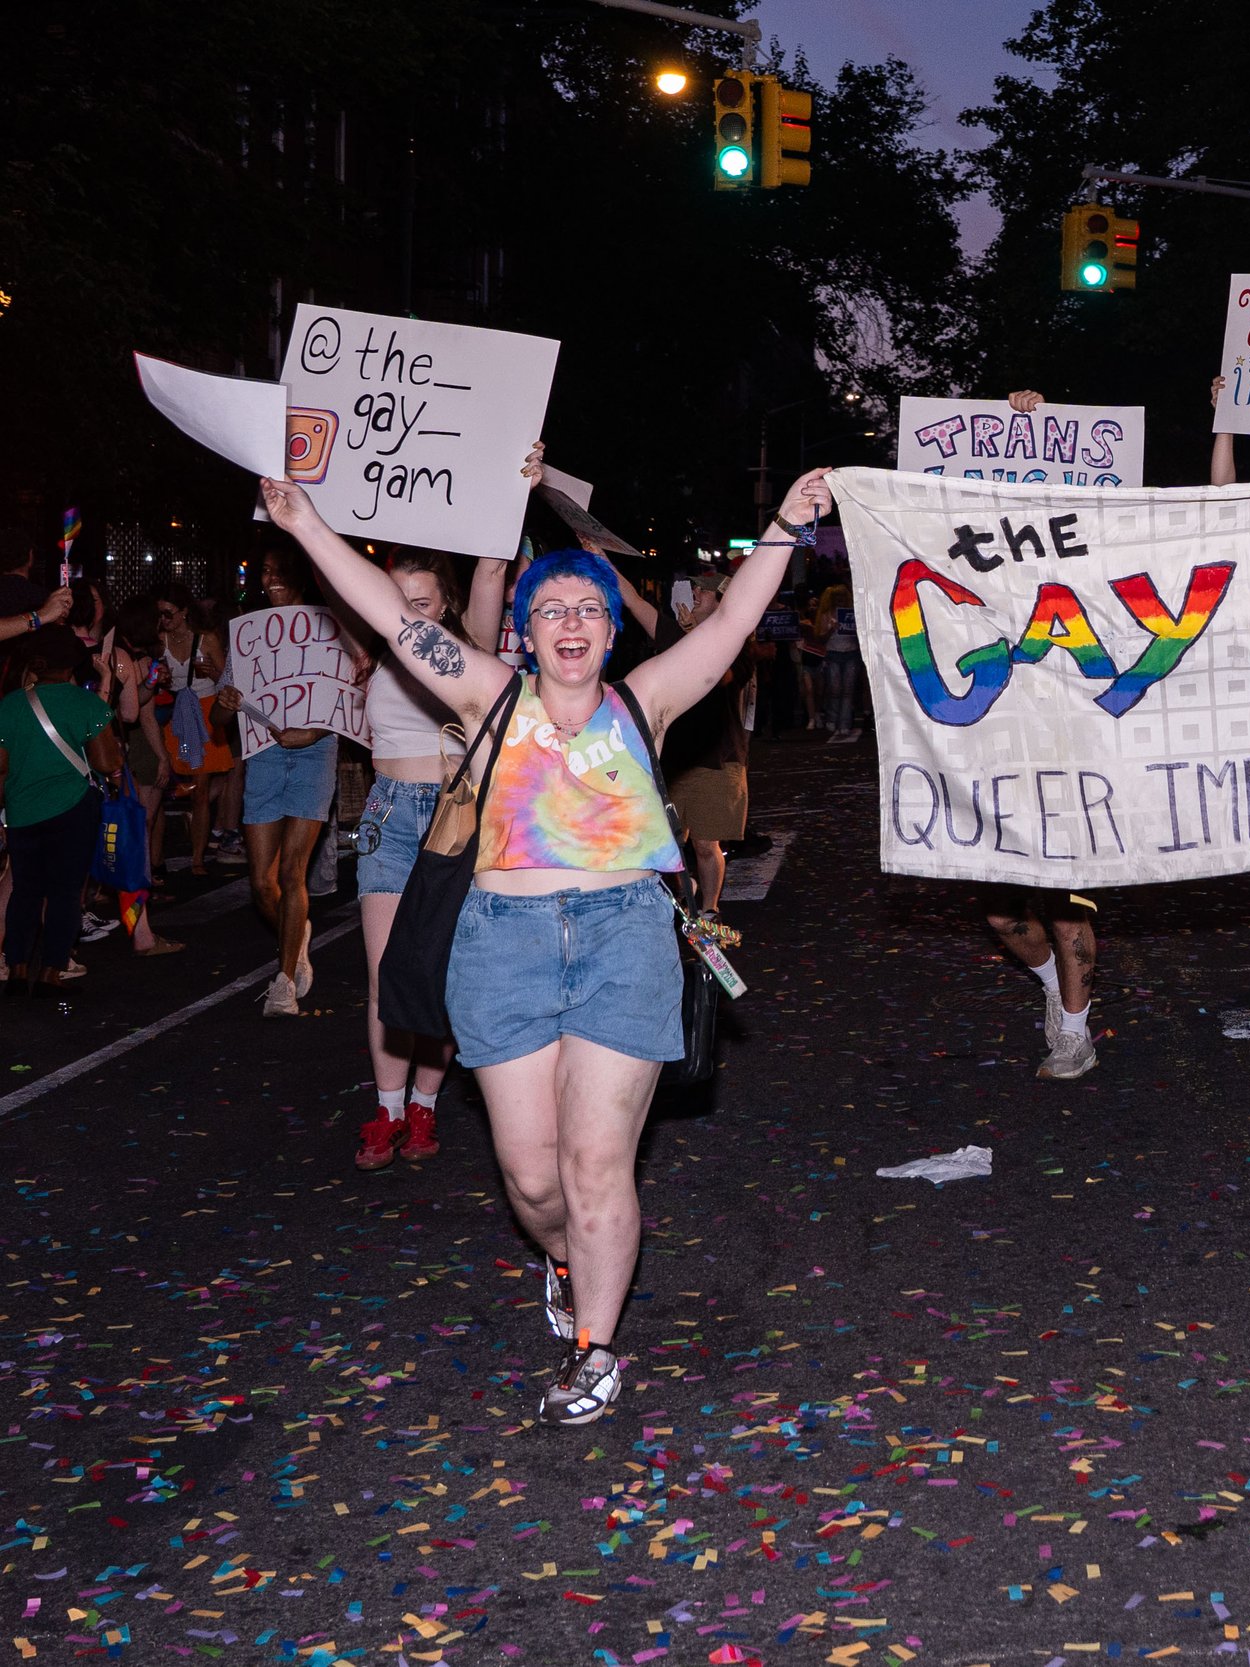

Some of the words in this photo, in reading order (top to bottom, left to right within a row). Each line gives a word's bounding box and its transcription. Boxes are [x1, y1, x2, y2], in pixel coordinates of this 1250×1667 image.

[914, 413, 1124, 469] TRANS
[352, 460, 453, 521] gam
[236, 611, 342, 658] GOOD
[890, 558, 1238, 728] GAY
[251, 644, 366, 693] ALLI
[245, 681, 374, 756] APPLAU
[567, 718, 627, 777] and
[892, 762, 1126, 861] QUEER
